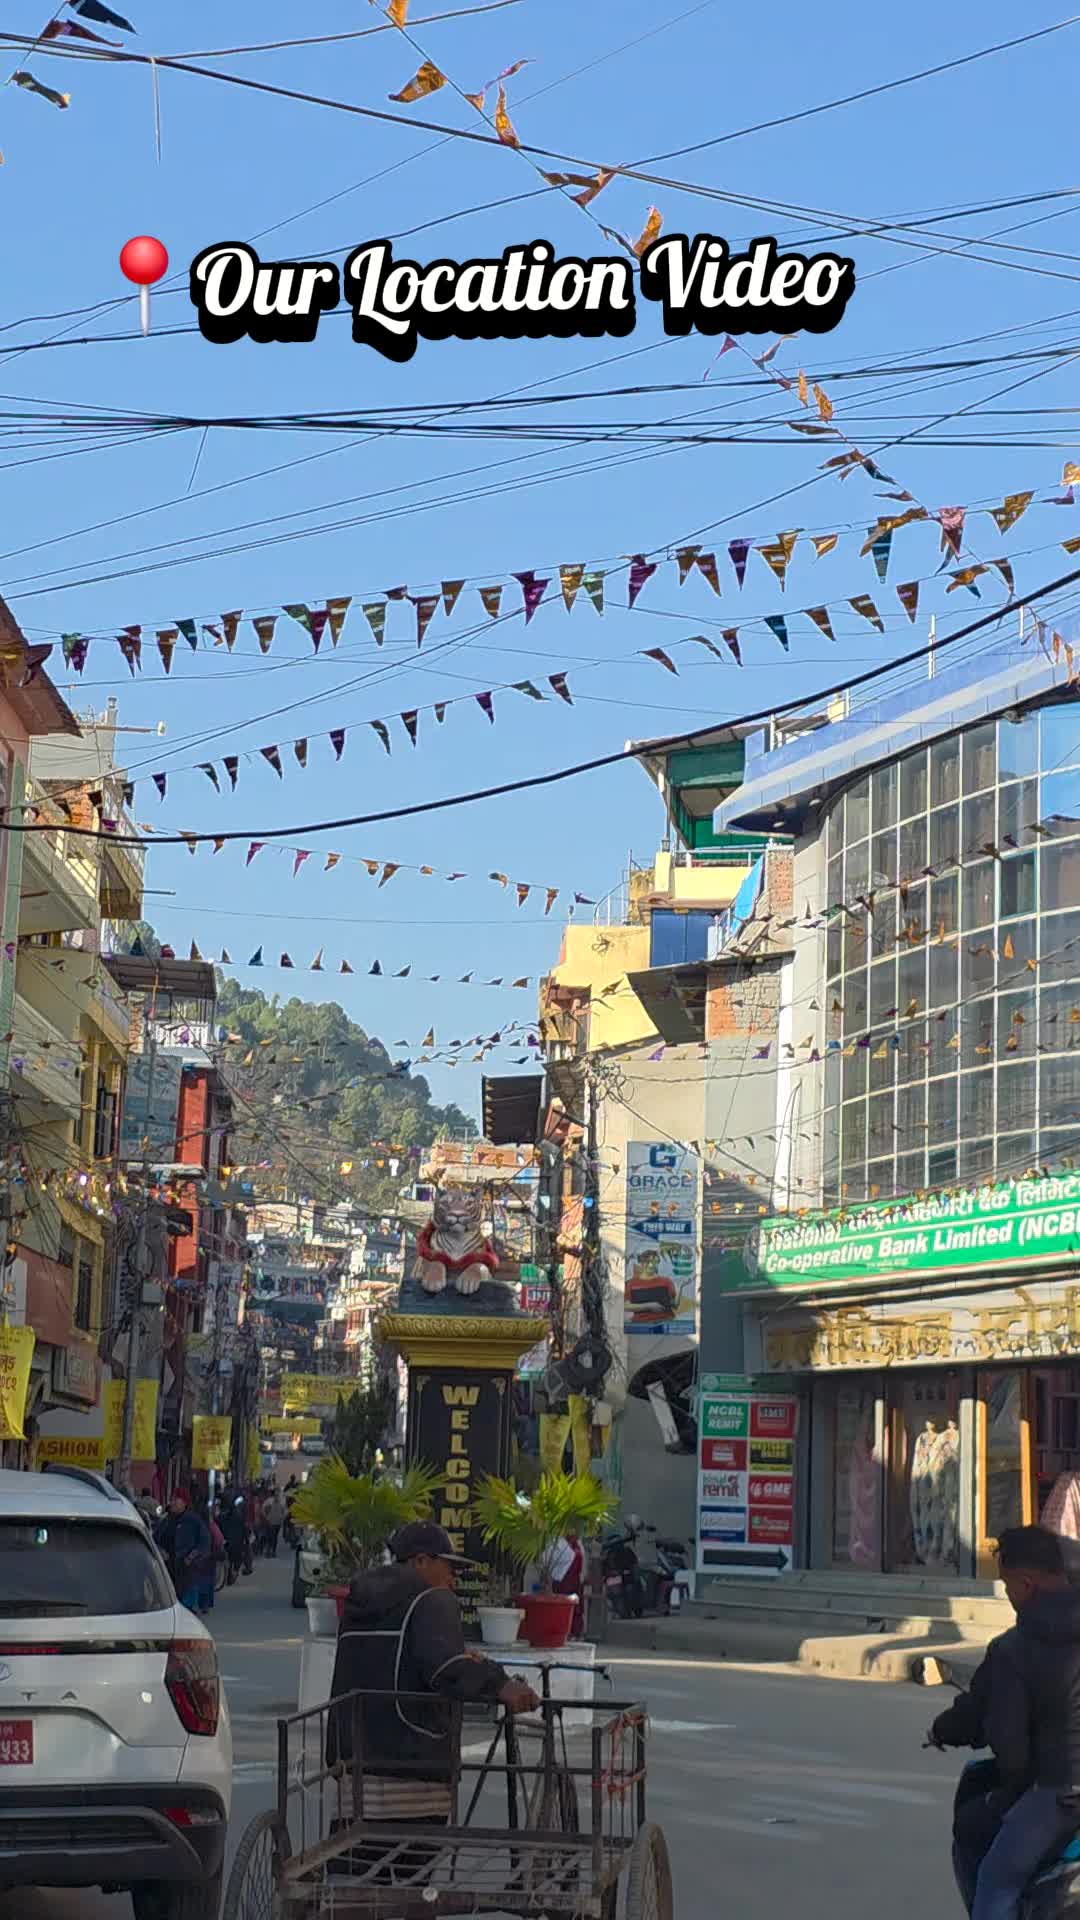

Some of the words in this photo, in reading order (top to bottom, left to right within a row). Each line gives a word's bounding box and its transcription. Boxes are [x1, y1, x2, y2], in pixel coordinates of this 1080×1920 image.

[629, 1175, 693, 1188] GRACE
[766, 1241, 874, 1274] Co-operative
[878, 1232, 930, 1258] Bank
[933, 1219, 1015, 1252] Limited
[36, 1439, 100, 1457] ASHION
[440, 1384, 481, 1553] WELCOME
[763, 1482, 792, 1495] GME
